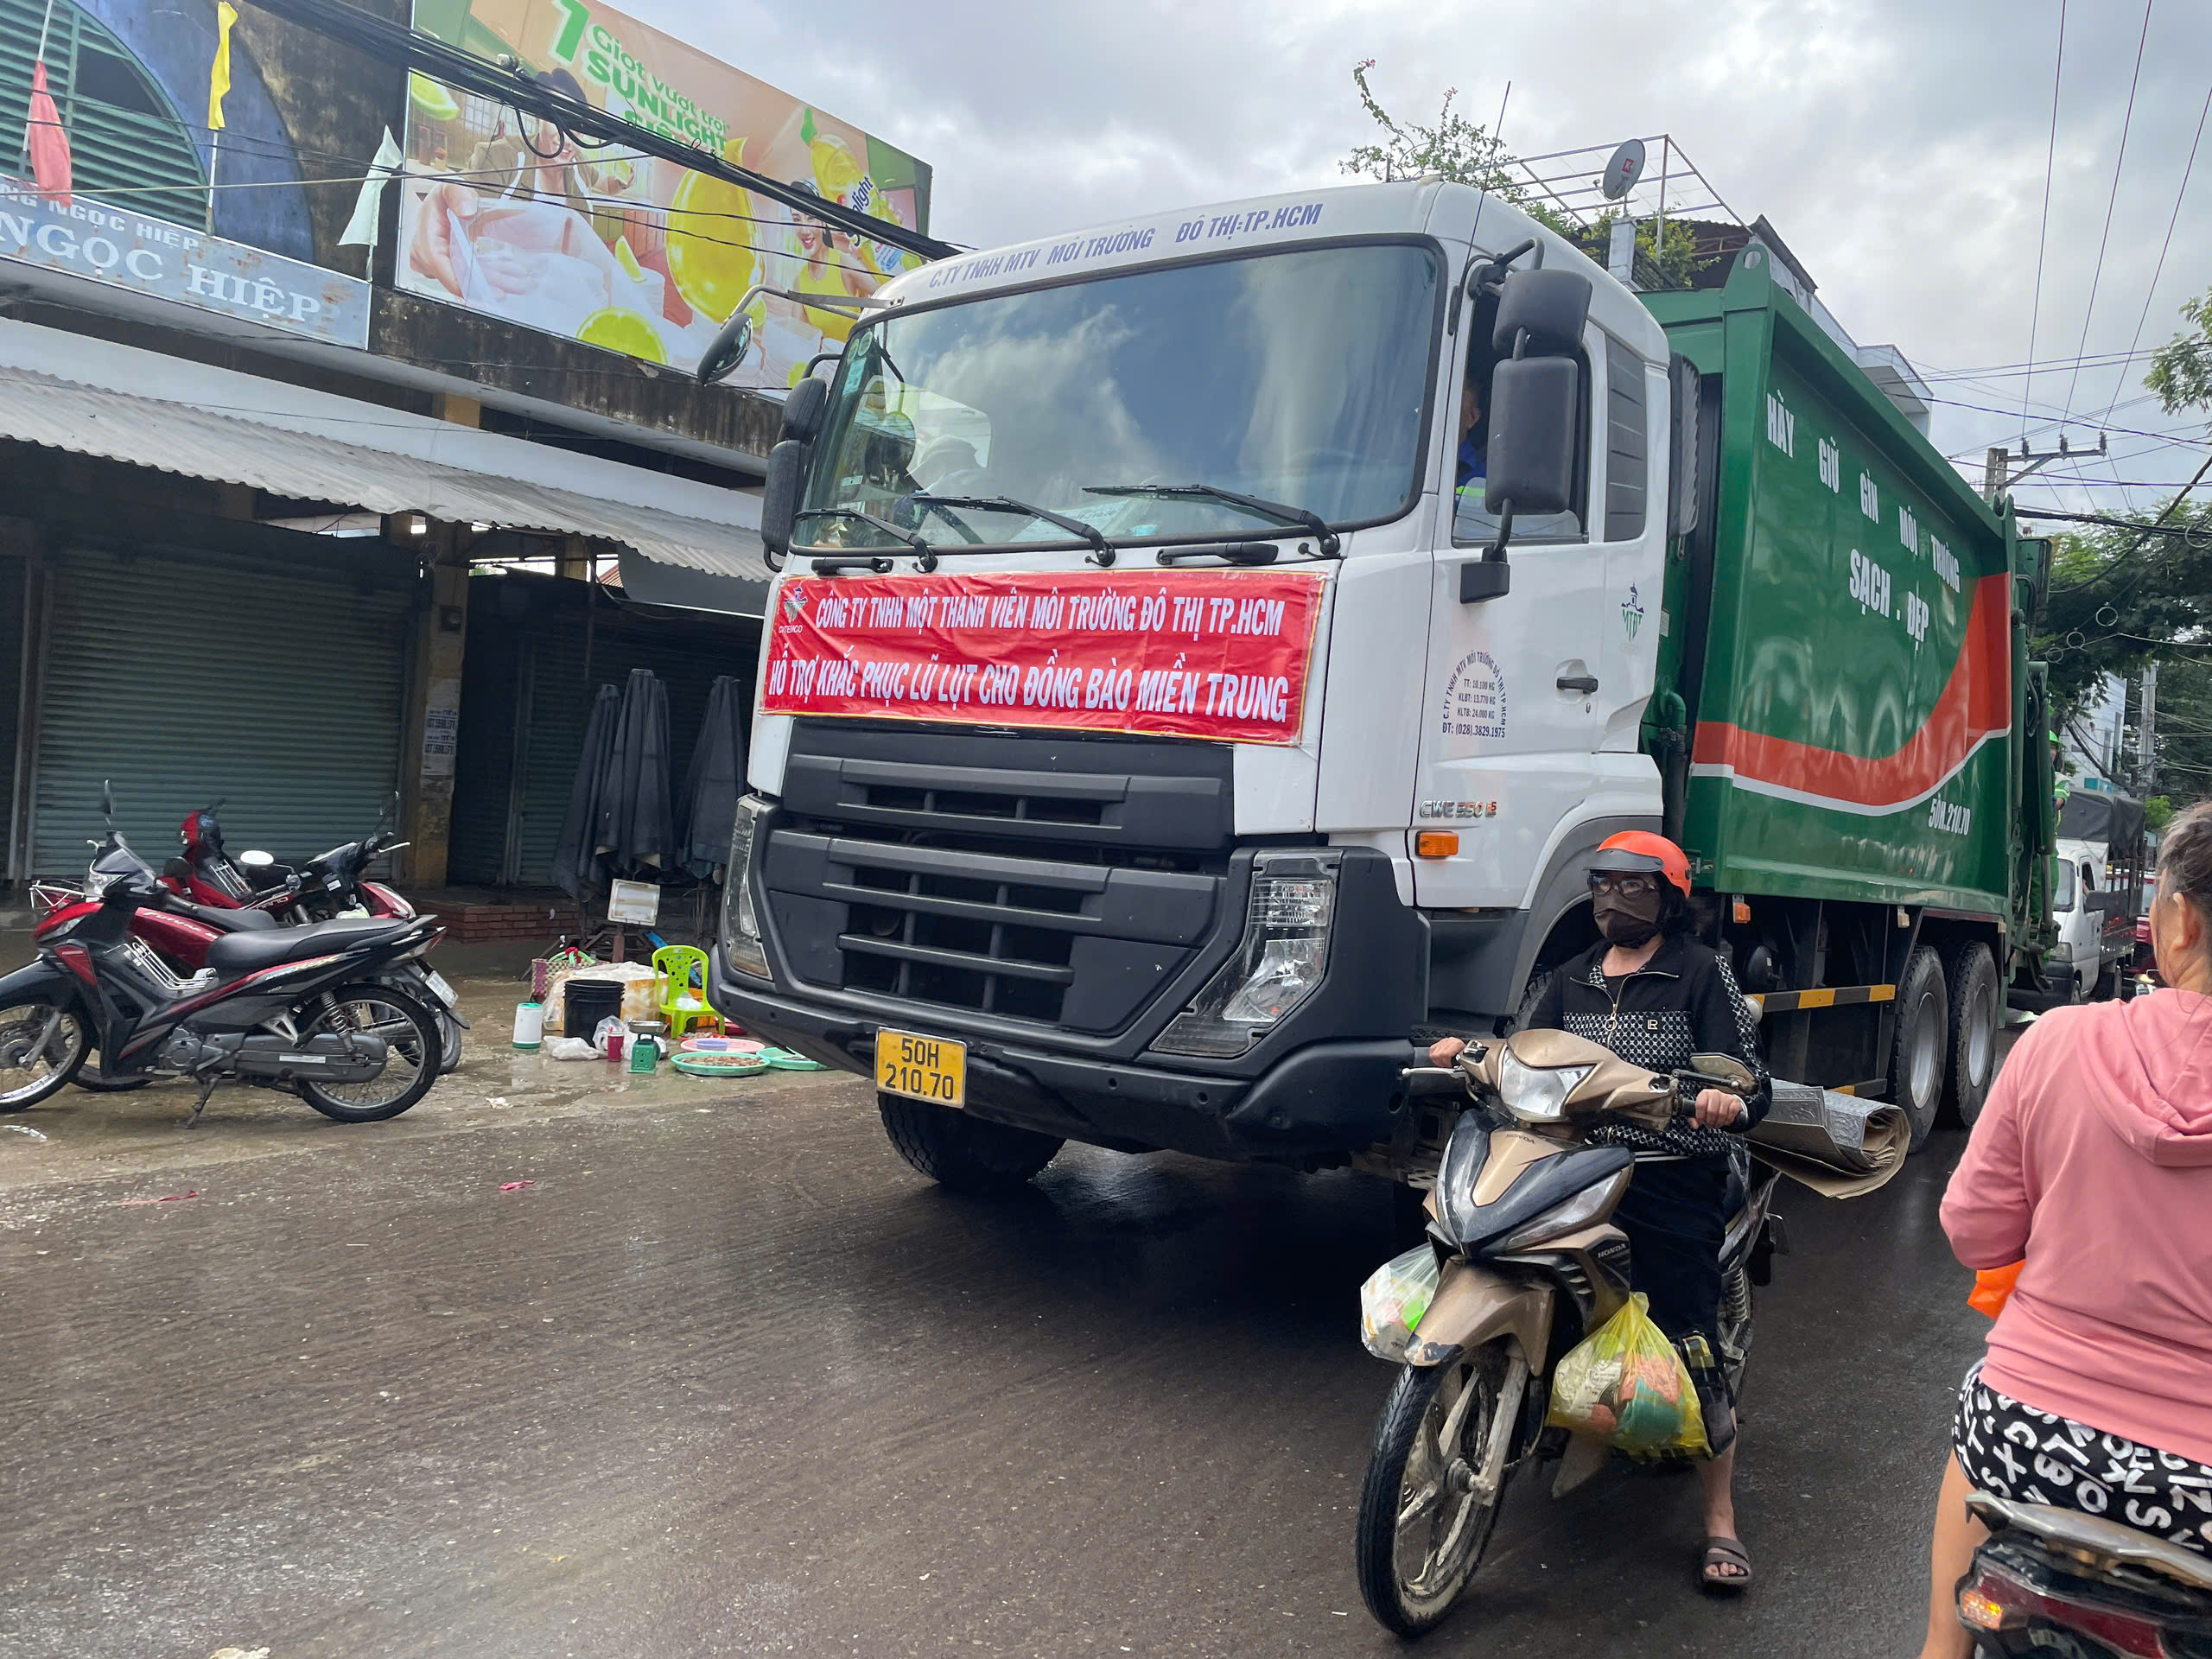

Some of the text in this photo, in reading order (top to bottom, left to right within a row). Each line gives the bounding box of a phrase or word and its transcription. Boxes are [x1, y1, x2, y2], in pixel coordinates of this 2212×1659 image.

[587, 49, 727, 152] SUNLIGHT
[0, 212, 321, 321] NGỌC HIỆP
[962, 256, 1006, 282] TNHH
[1002, 248, 1042, 273] MTV
[1175, 213, 1205, 243] ĐÔ
[815, 586, 1286, 643] CÔNG TY TNHH MỘT THÀNH VIÊN MÔI TRƯỜNG ĐÔ THỊ TP.HCM
[767, 641, 1290, 723] HỖ TRỢ KHẮC PHỤC LŨ LỤT CHO ĐỒNG BÀO MIỀN TRUNG
[885, 1063, 954, 1100] 210.70
[901, 1037, 939, 1068] 50H
[1597, 1243, 1626, 1259] HONDA
